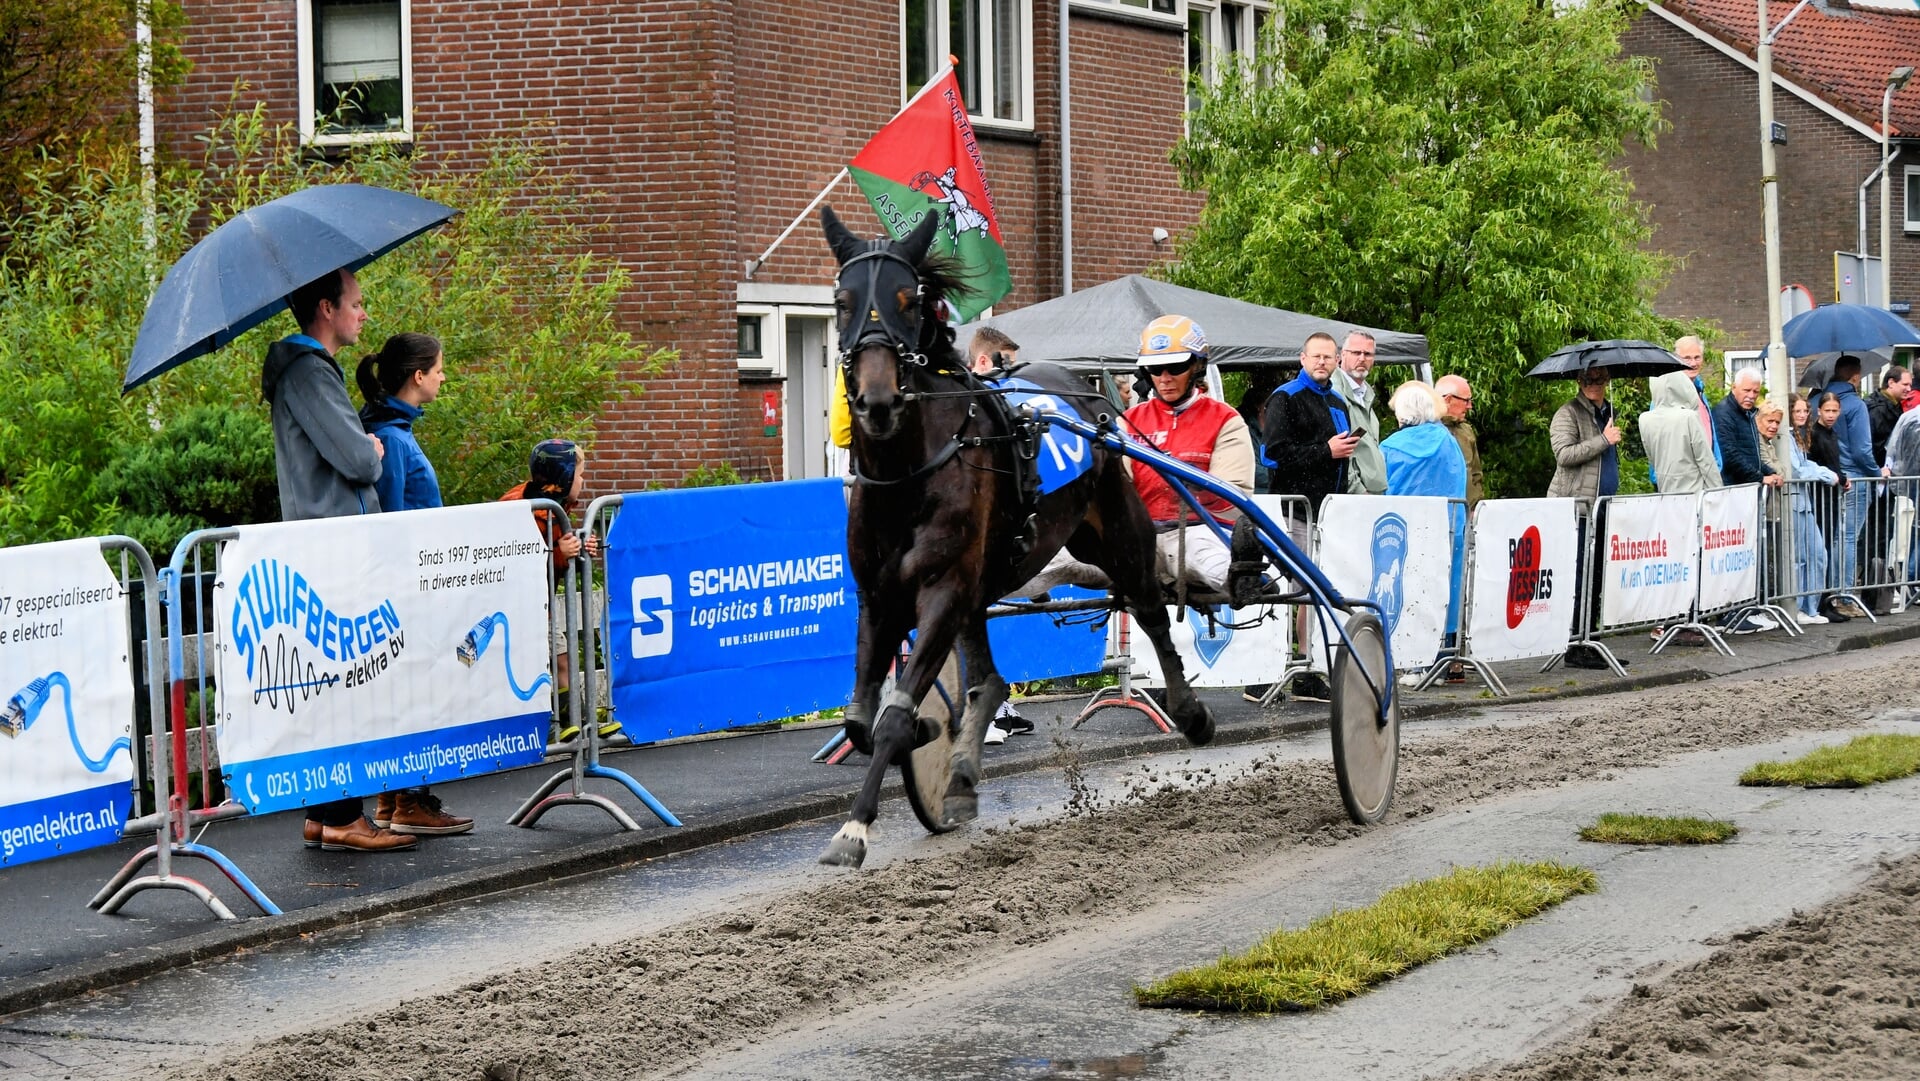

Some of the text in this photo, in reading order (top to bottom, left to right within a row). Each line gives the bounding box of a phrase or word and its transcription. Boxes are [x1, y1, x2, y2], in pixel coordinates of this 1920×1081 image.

[418, 539, 541, 567] Sinds 1997 gespecialiseerd
[1509, 537, 1532, 569] ROB
[419, 565, 506, 591] in diverse elektra!
[689, 554, 843, 597] SCHAVEMAKER
[16, 582, 113, 618] gespecialiseerd
[689, 587, 845, 630] Logistics & Transport
[12, 618, 63, 643] elektra!
[232, 558, 400, 683] STUIJFBERGEN
[719, 624, 820, 648] WWW.SCHAVEMAKER.COM
[345, 630, 405, 688] elektra bv
[266, 727, 541, 798] 0251 310 481 www.stuijfbergenelektra.nl
